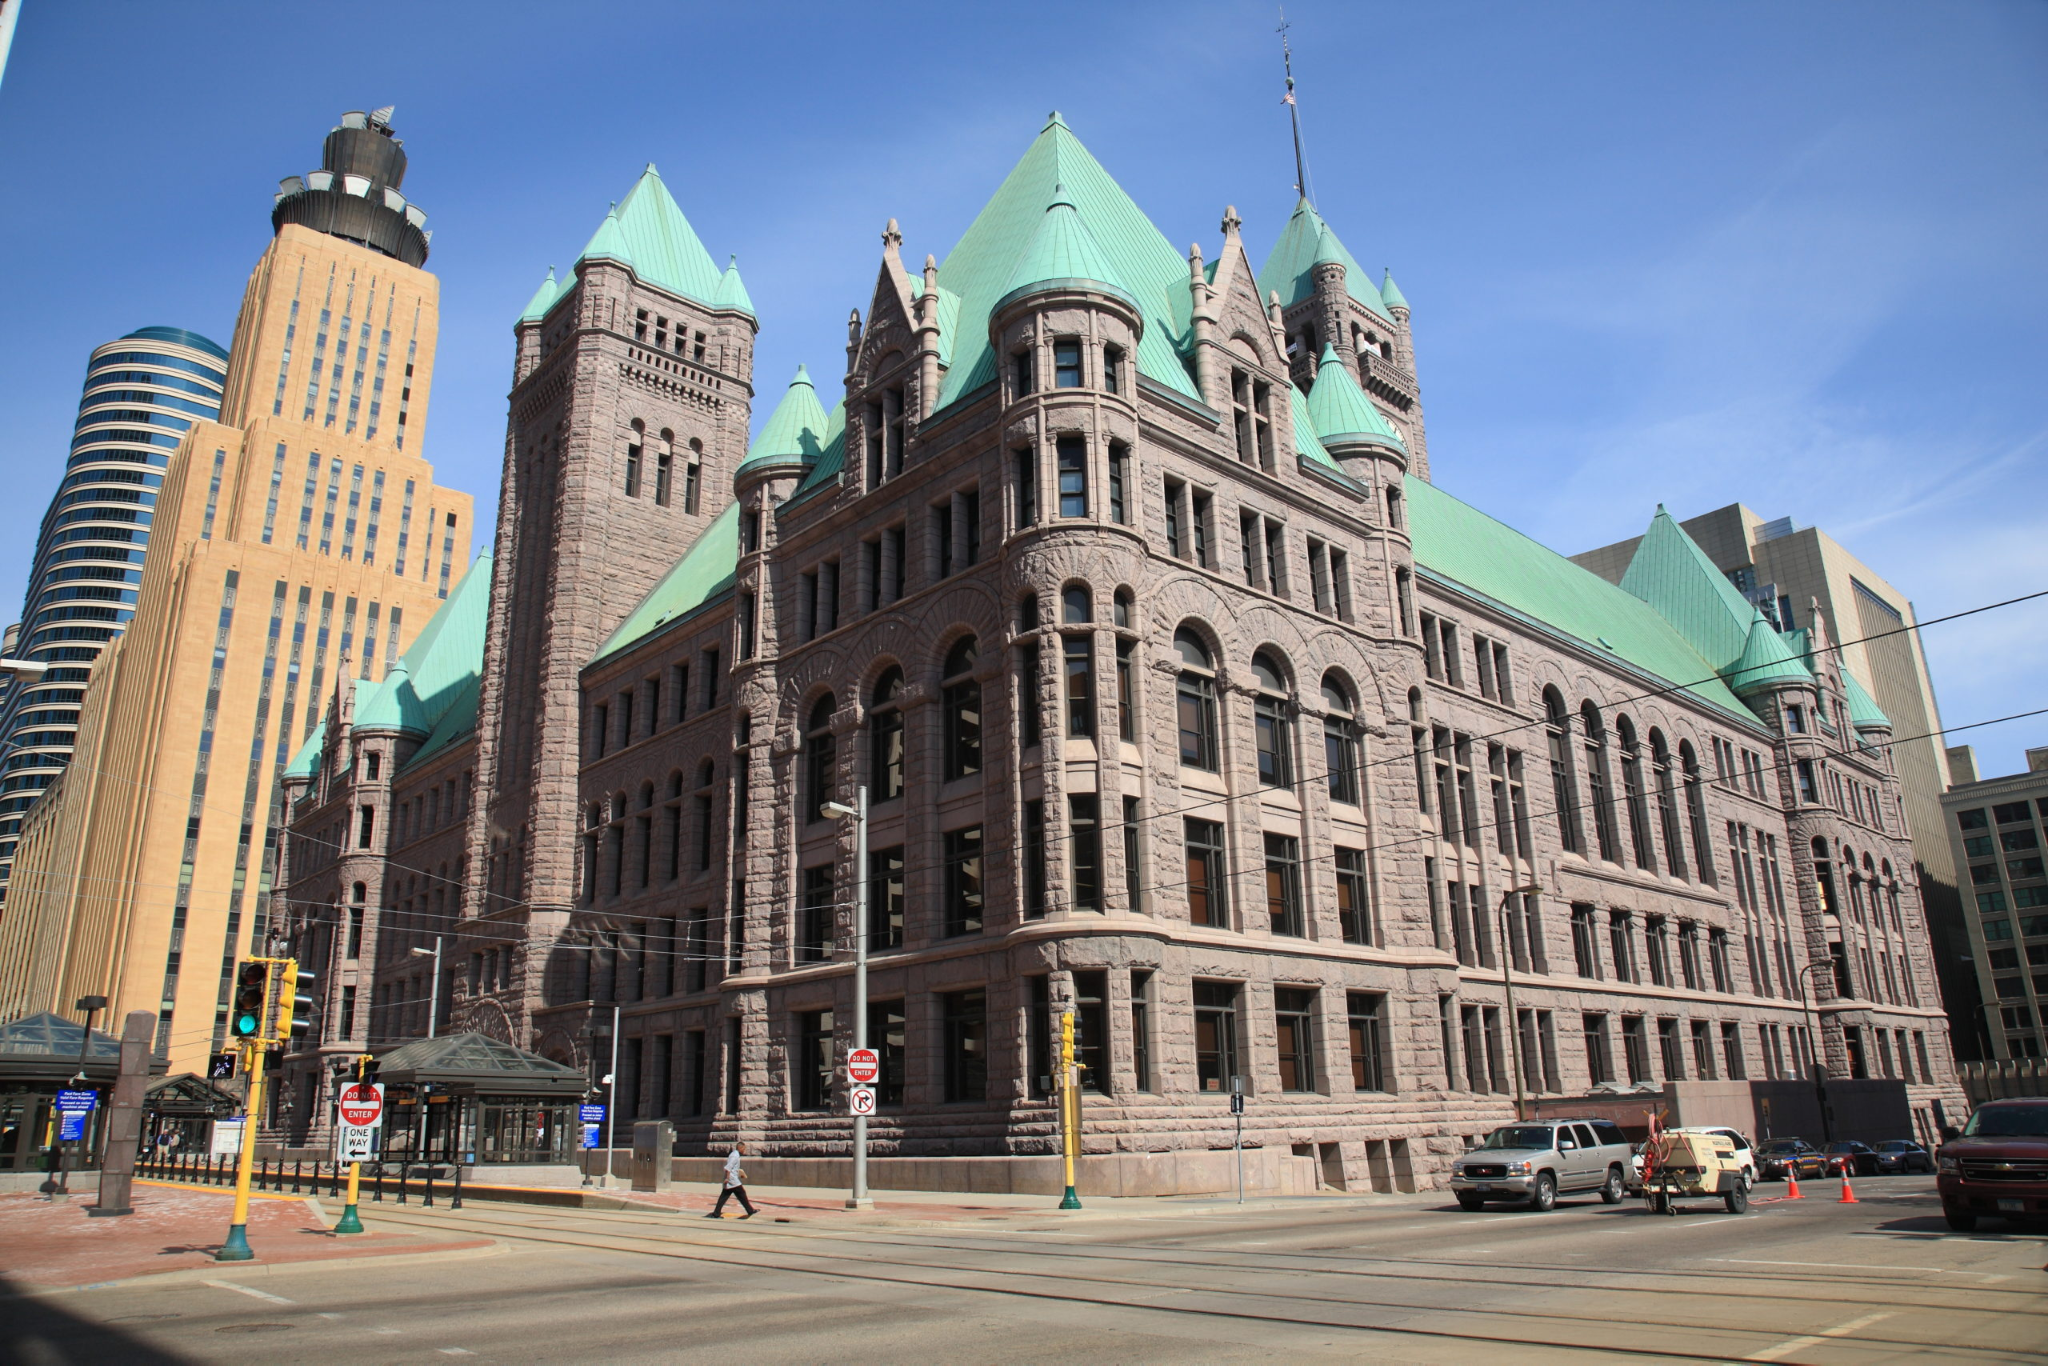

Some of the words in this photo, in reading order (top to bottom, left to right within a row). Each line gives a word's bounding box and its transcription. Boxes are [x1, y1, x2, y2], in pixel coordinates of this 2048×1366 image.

[348, 1110, 372, 1118] ENTER
[350, 1128, 369, 1136] ONE
[349, 1138, 367, 1147] WAY
